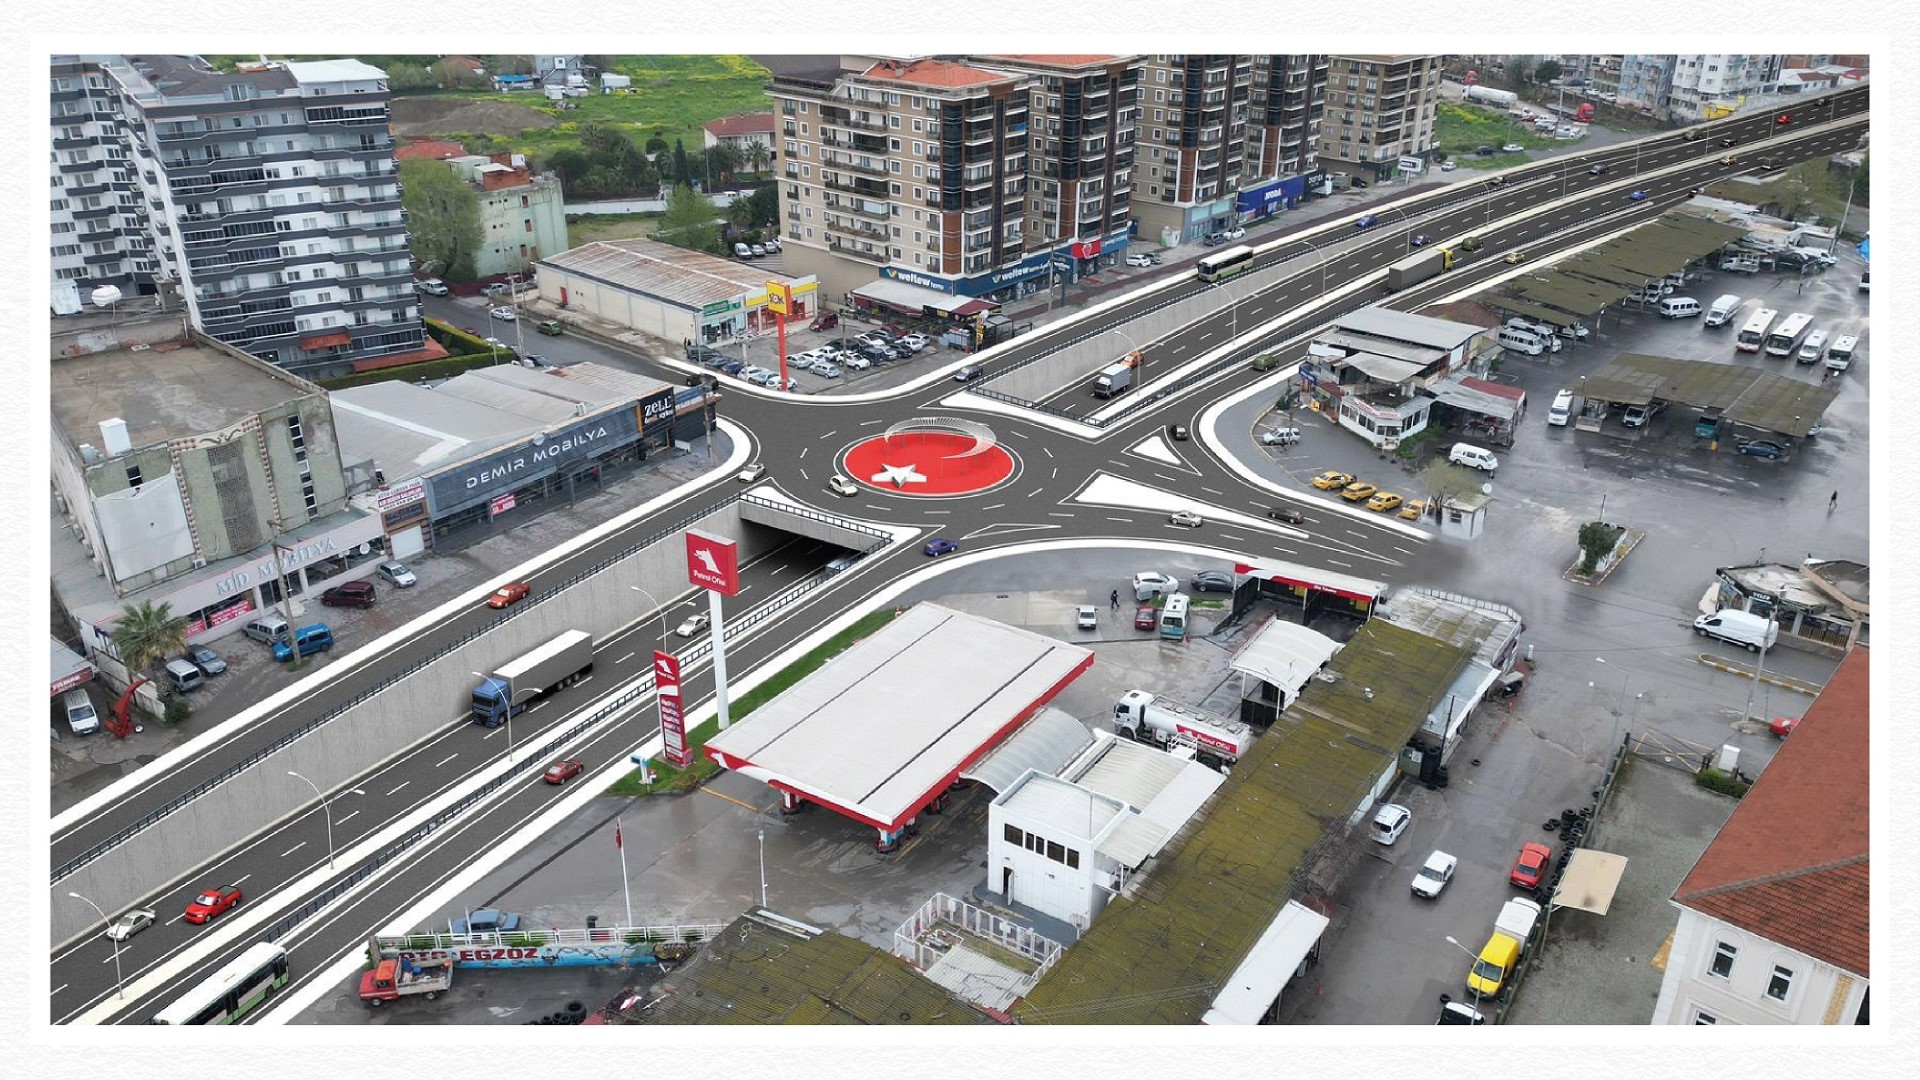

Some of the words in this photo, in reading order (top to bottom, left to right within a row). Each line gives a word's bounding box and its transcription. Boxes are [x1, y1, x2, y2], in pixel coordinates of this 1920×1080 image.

[897, 272, 931, 287] weltew
[466, 458, 525, 489] DEMİR
[532, 426, 608, 464] MOBİLYA
[693, 569, 711, 582] Petrol
[460, 948, 539, 962] EGZOZ
